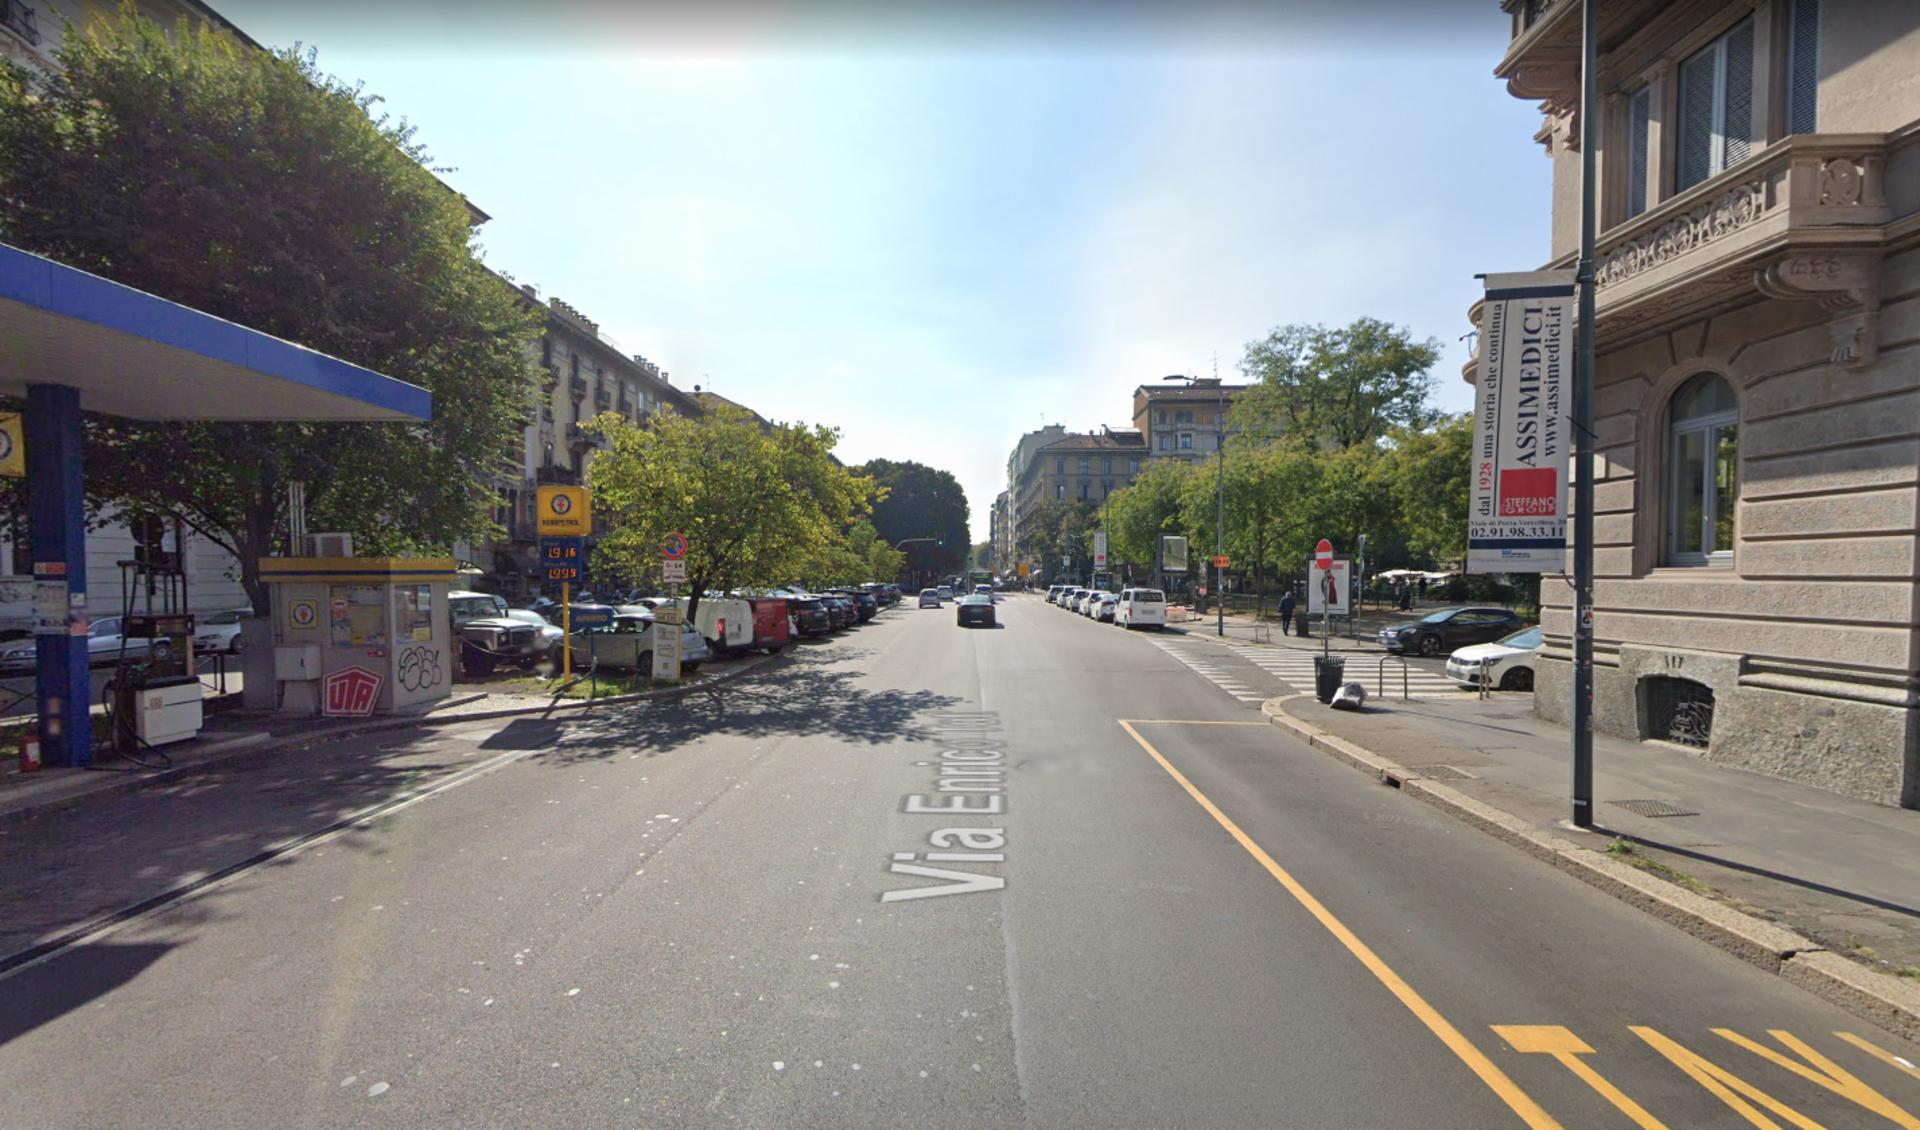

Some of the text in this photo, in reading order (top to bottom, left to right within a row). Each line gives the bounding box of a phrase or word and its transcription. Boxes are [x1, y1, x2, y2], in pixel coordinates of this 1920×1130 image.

[1478, 303, 1502, 516] dal 1928 una storia che continua
[1516, 306, 1544, 468] ASSIMEDICI
[1544, 304, 1562, 458] www.assimedici.it
[1471, 526, 1564, 538] 02.91.98.33.11
[1505, 496, 1555, 507] STEFFANO
